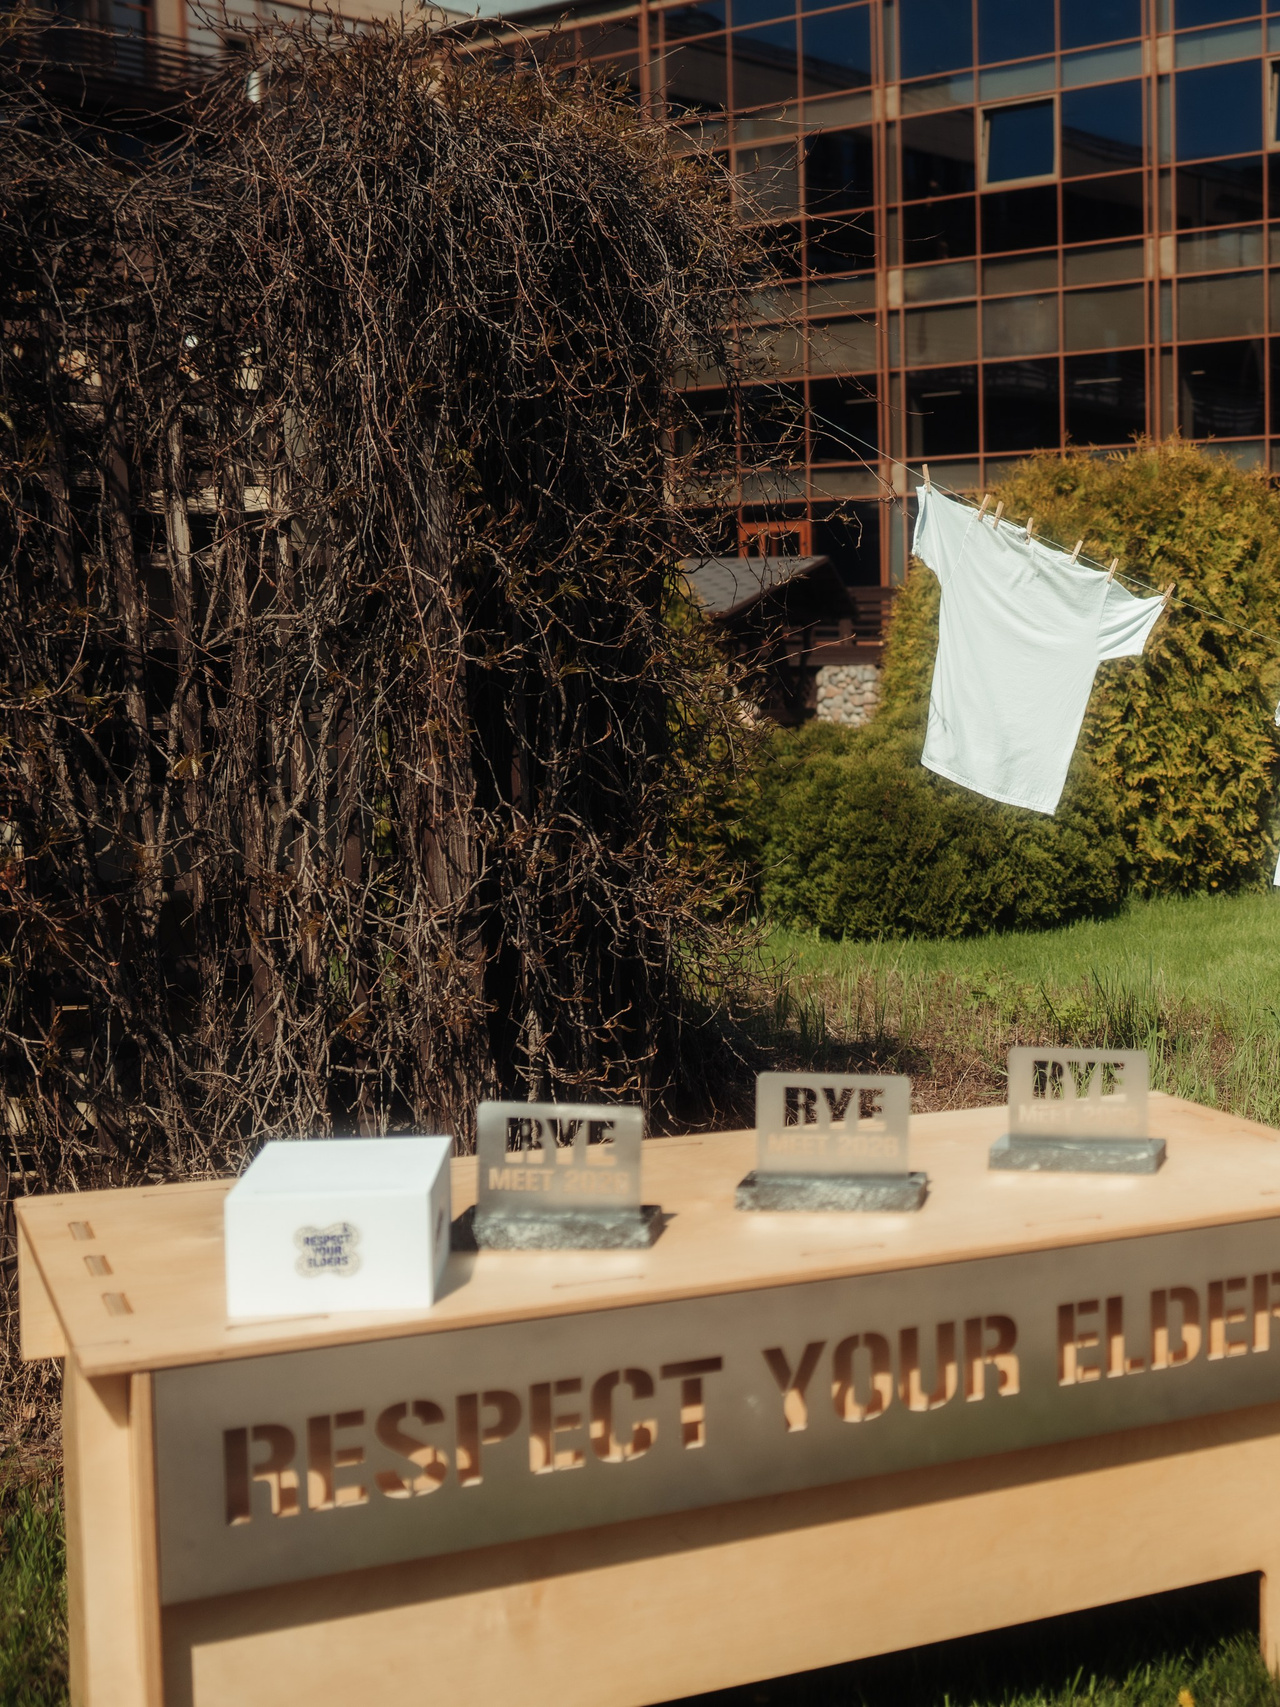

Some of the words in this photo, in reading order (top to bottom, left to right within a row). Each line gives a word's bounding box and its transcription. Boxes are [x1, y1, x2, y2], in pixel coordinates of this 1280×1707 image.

[1032, 1060, 1127, 1103] RYE
[784, 1086, 887, 1132] RYE
[505, 1117, 618, 1167] RYE
[488, 1168, 553, 1192] MEET
[303, 1234, 351, 1247] RESPECT
[312, 1246, 343, 1256] YOUR
[307, 1256, 349, 1269] ELDERS
[222, 1356, 724, 1527] RESPECT
[761, 1314, 1021, 1434] YOUR
